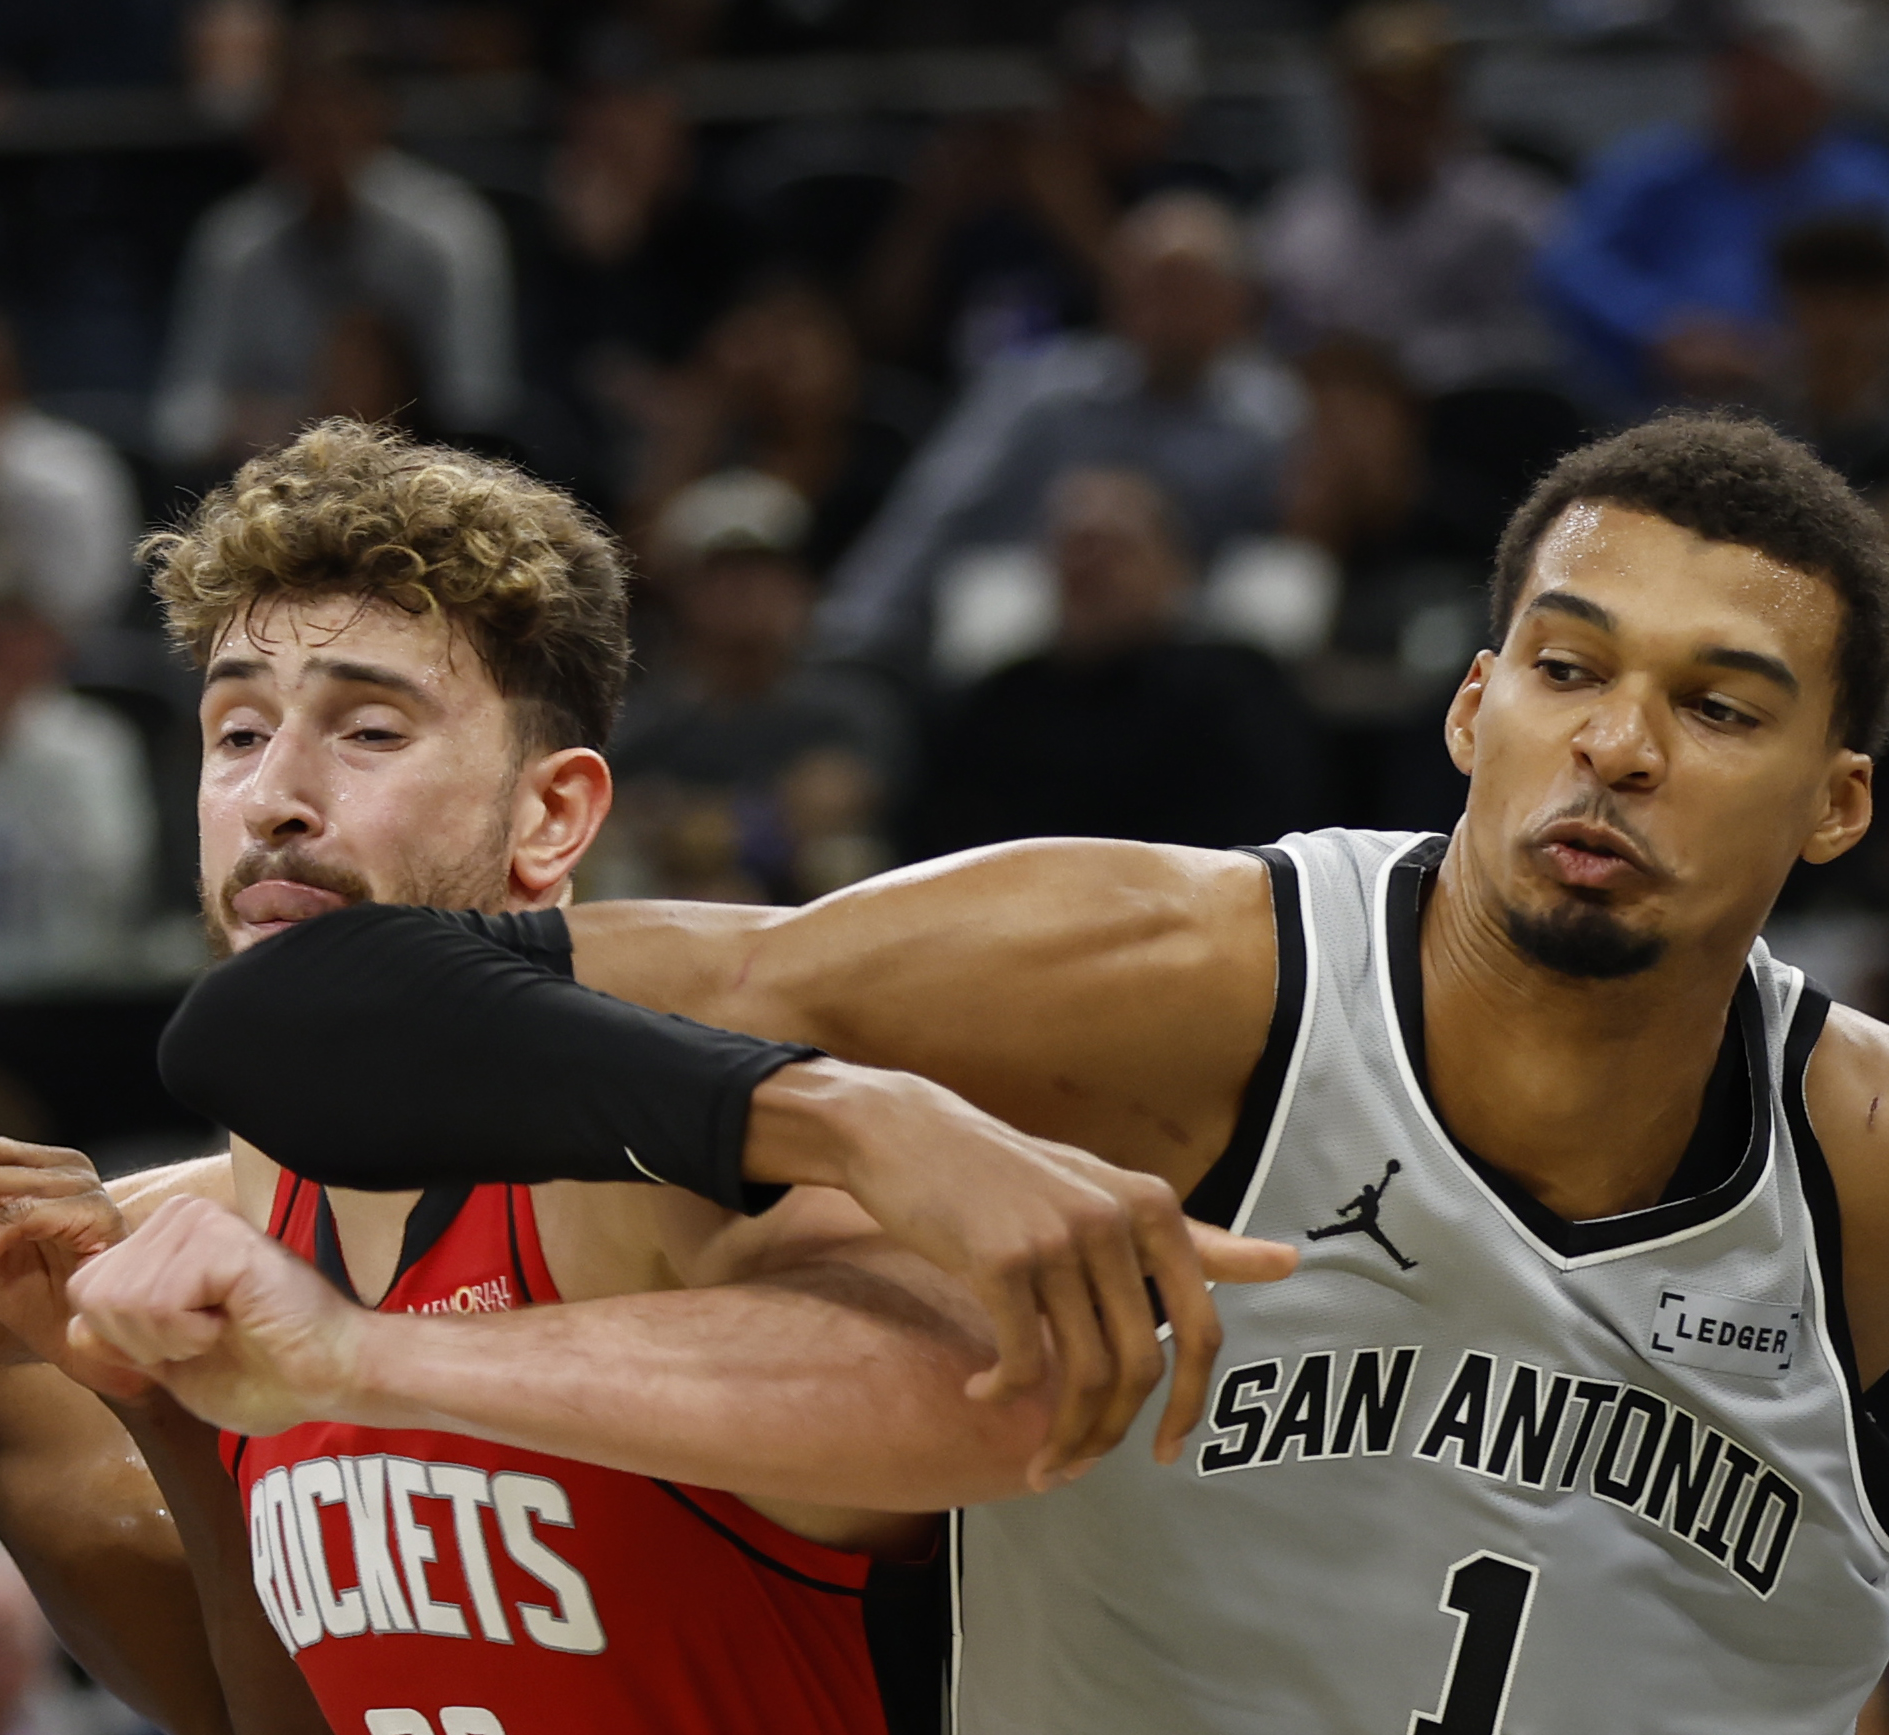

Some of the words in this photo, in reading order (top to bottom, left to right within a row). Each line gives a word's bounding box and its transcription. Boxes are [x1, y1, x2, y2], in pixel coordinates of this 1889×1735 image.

[1676, 1313, 1788, 1354] LEDGER
[249, 1453, 608, 1659] ROCKETS
[1196, 1346, 1421, 1477] SAN
[1413, 1350, 1804, 1601] ANTONIO
